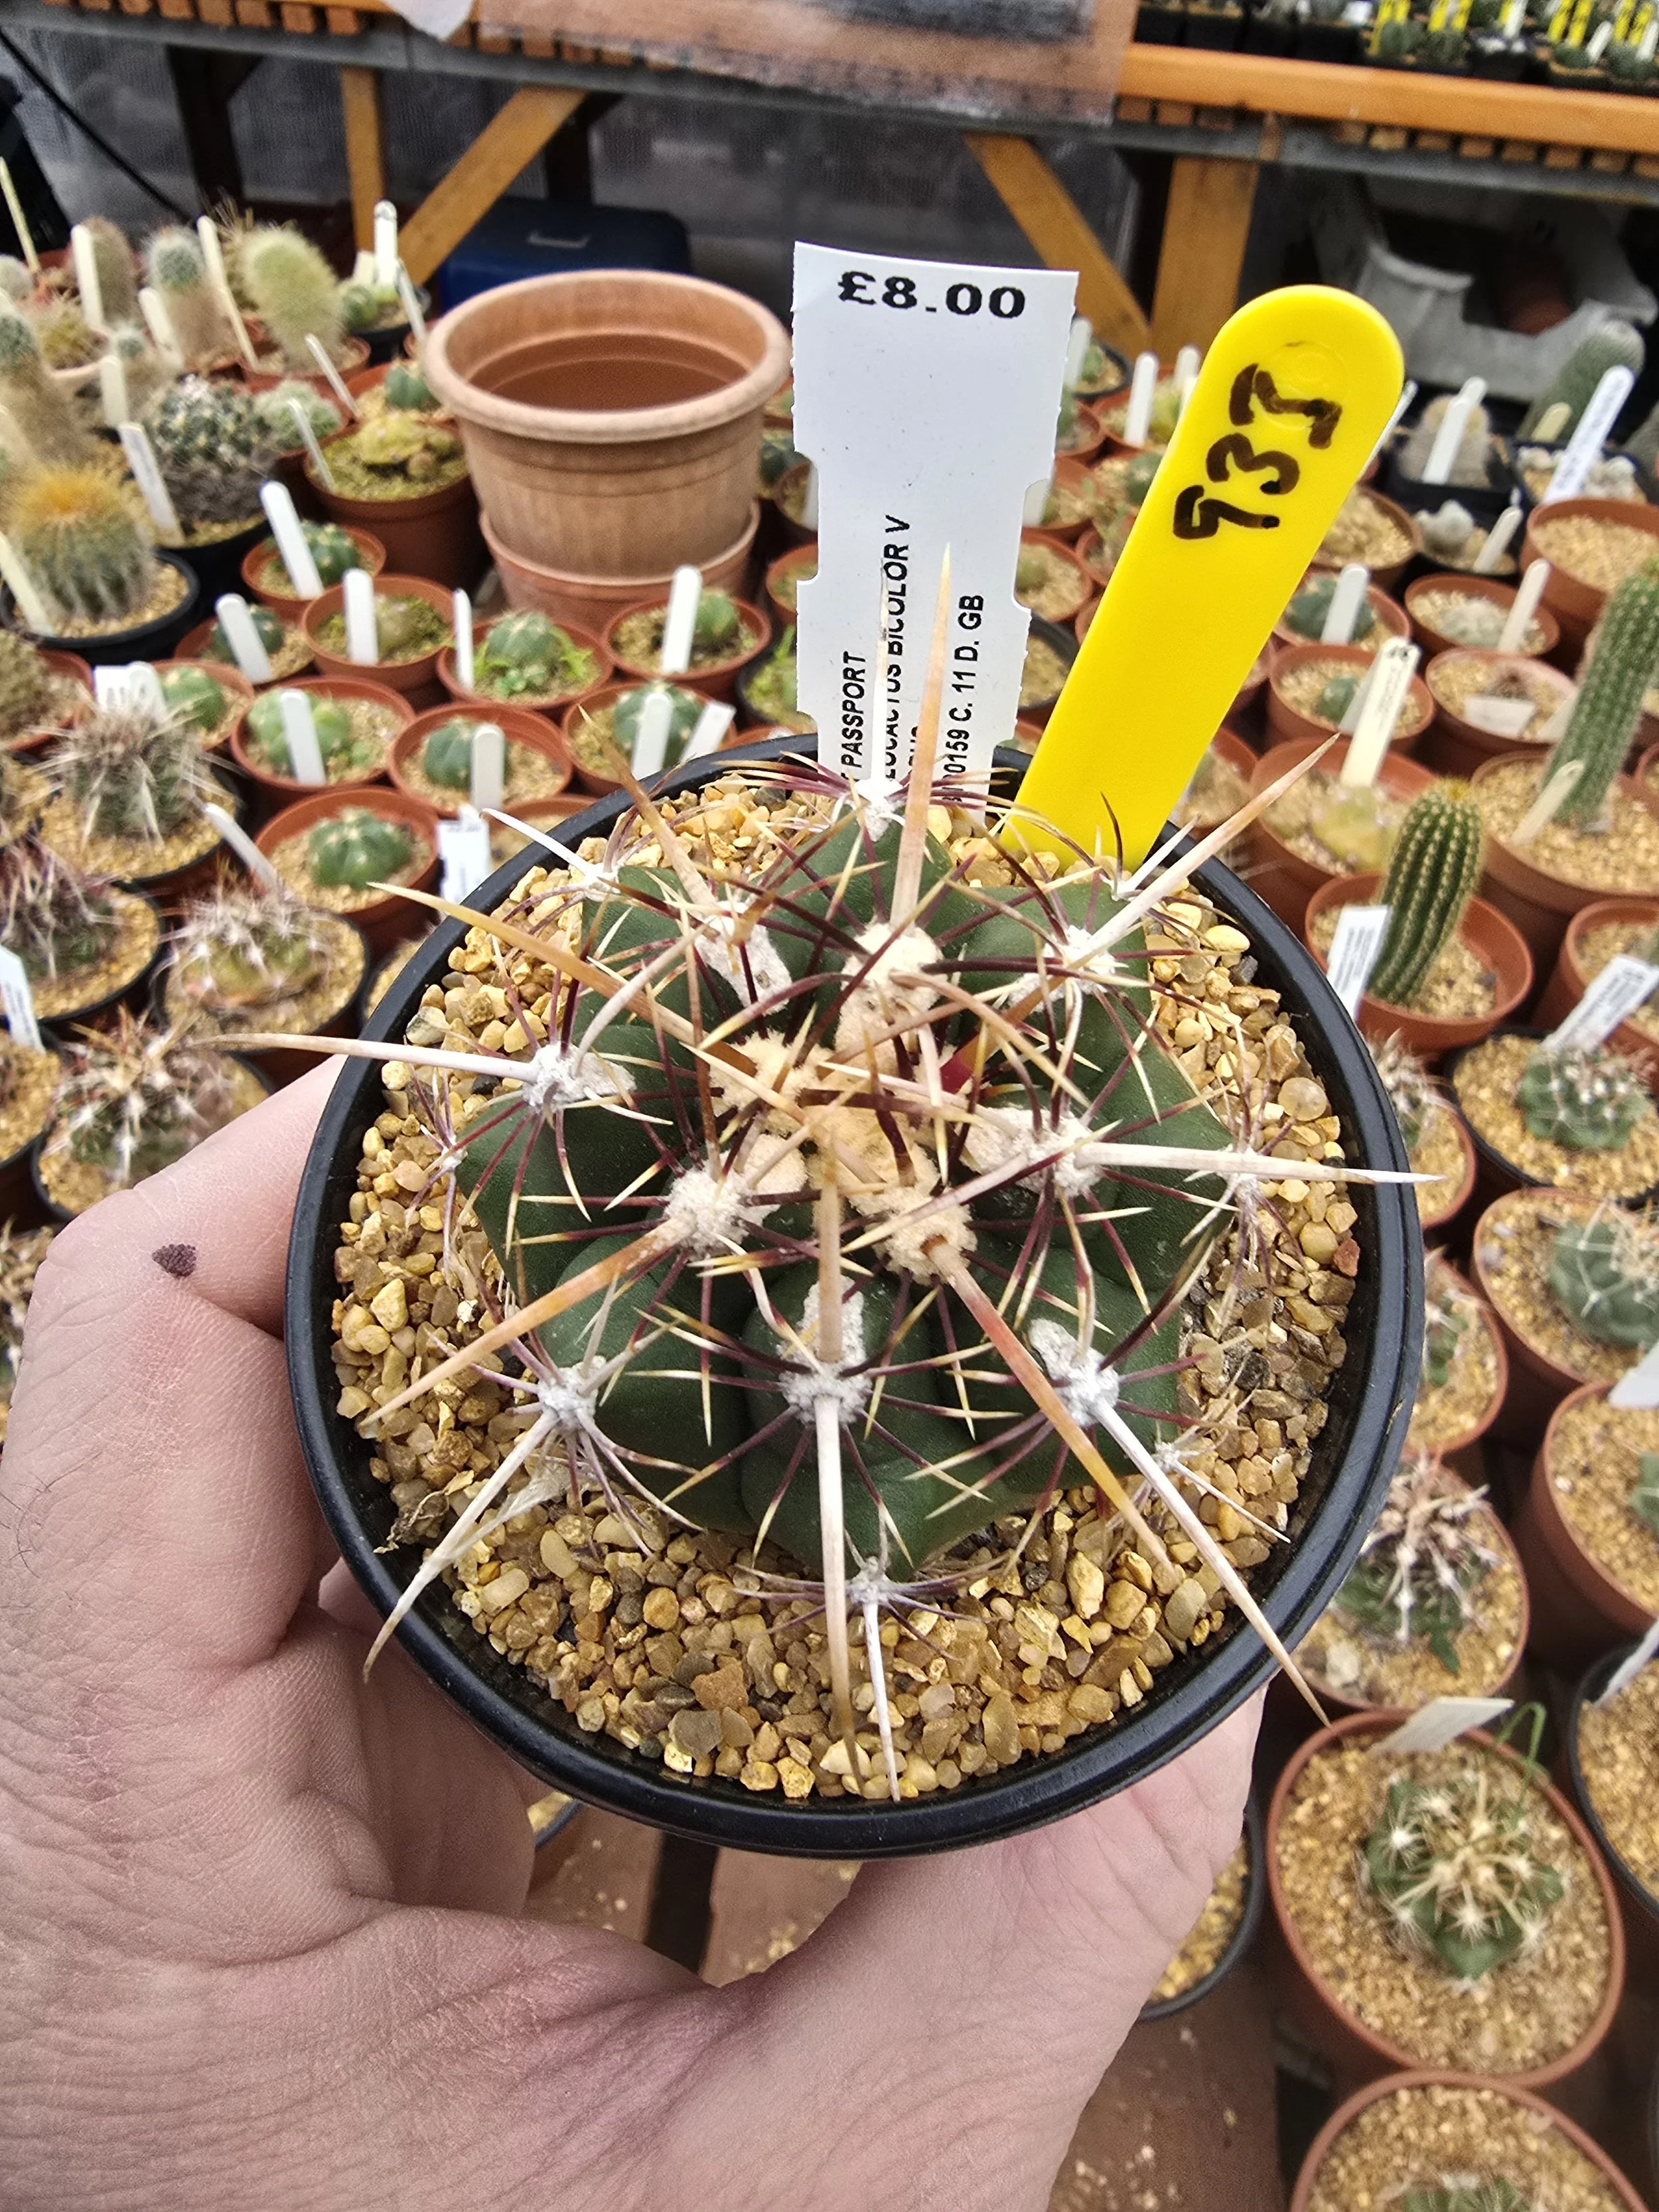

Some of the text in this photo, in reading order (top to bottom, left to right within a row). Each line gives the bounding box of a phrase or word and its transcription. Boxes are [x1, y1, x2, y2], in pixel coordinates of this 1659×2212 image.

[837, 271, 1026, 319] £8.00
[958, 595, 984, 630] GB
[884, 514, 910, 780] LOCACTUS BICOLOR V
[954, 640, 979, 662] D.
[952, 670, 976, 692] 11
[841, 650, 865, 768] PASSPORT
[949, 702, 973, 721] C.
